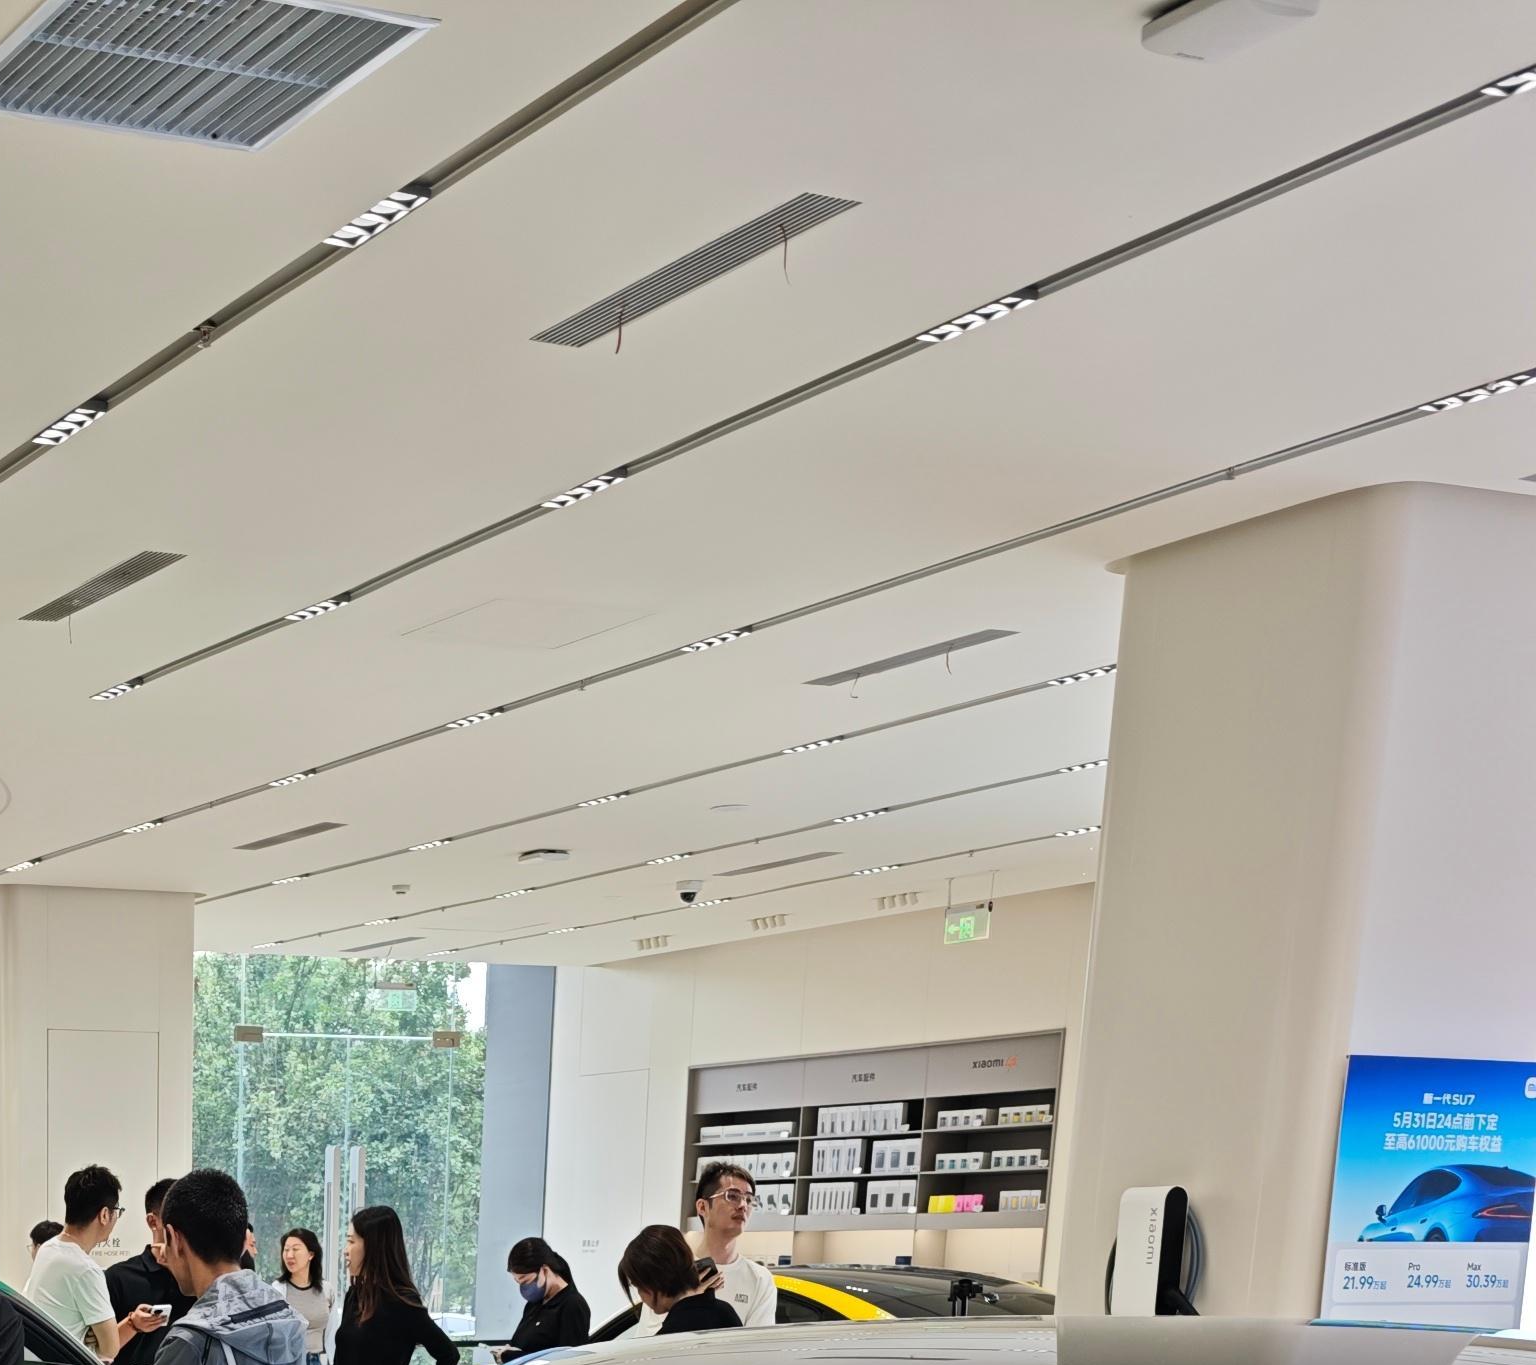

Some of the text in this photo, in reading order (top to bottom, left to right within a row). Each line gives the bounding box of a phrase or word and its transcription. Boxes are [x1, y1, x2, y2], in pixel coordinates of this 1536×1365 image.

[1393, 1111, 1499, 1131] 5月31日24点前下定
[1383, 1132, 1503, 1153] 至高61000元购车权益
[1344, 1261, 1367, 1272] 标准版
[1408, 1262, 1421, 1272] Pro
[1467, 1262, 1481, 1272] Max
